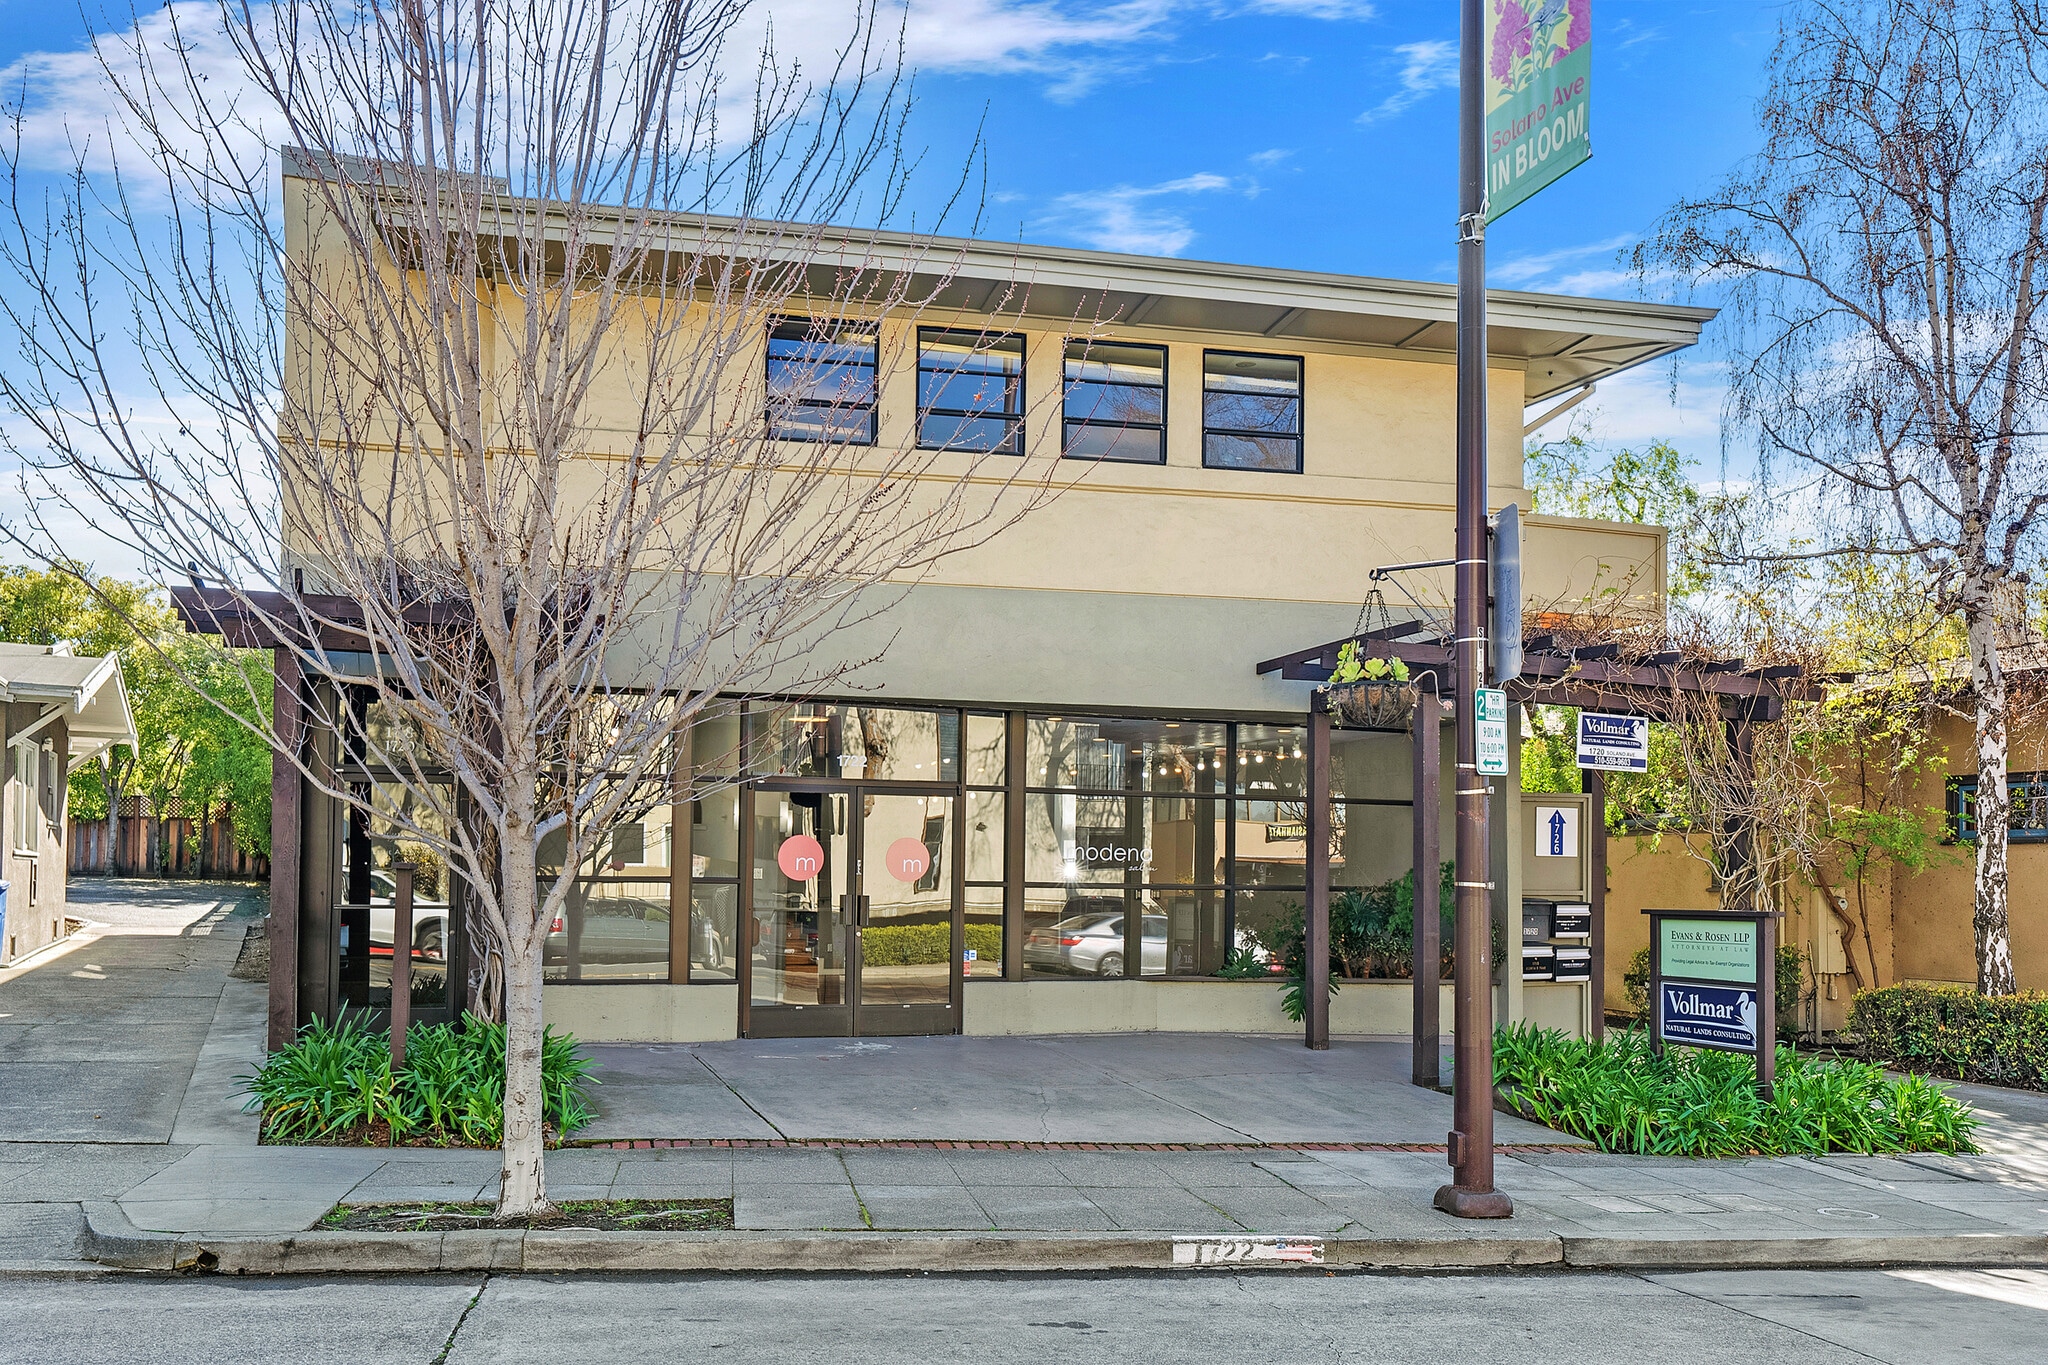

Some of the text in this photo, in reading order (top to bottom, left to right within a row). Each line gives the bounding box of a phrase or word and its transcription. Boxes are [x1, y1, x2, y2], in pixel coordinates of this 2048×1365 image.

[1491, 76, 1585, 153] Solano Ave
[1492, 154, 1510, 194] IN
[1477, 695, 1500, 717] 2 HR
[1486, 707, 1505, 719] PARKING
[1495, 727, 1502, 738] AM
[1585, 718, 1630, 735] Vollmar
[1480, 742, 1486, 753] TO
[1498, 743, 1505, 754] PM
[1589, 748, 1605, 756] 1720
[837, 754, 868, 767] 1722
[1553, 813, 1561, 854] 1726
[795, 855, 816, 871] m
[902, 857, 922, 873] m
[1671, 930, 1750, 943] EVANS & ROSEN LLP
[1667, 990, 1734, 1019] Vollmar
[1665, 1023, 1751, 1041] NATURAL LANDS CONSULTING
